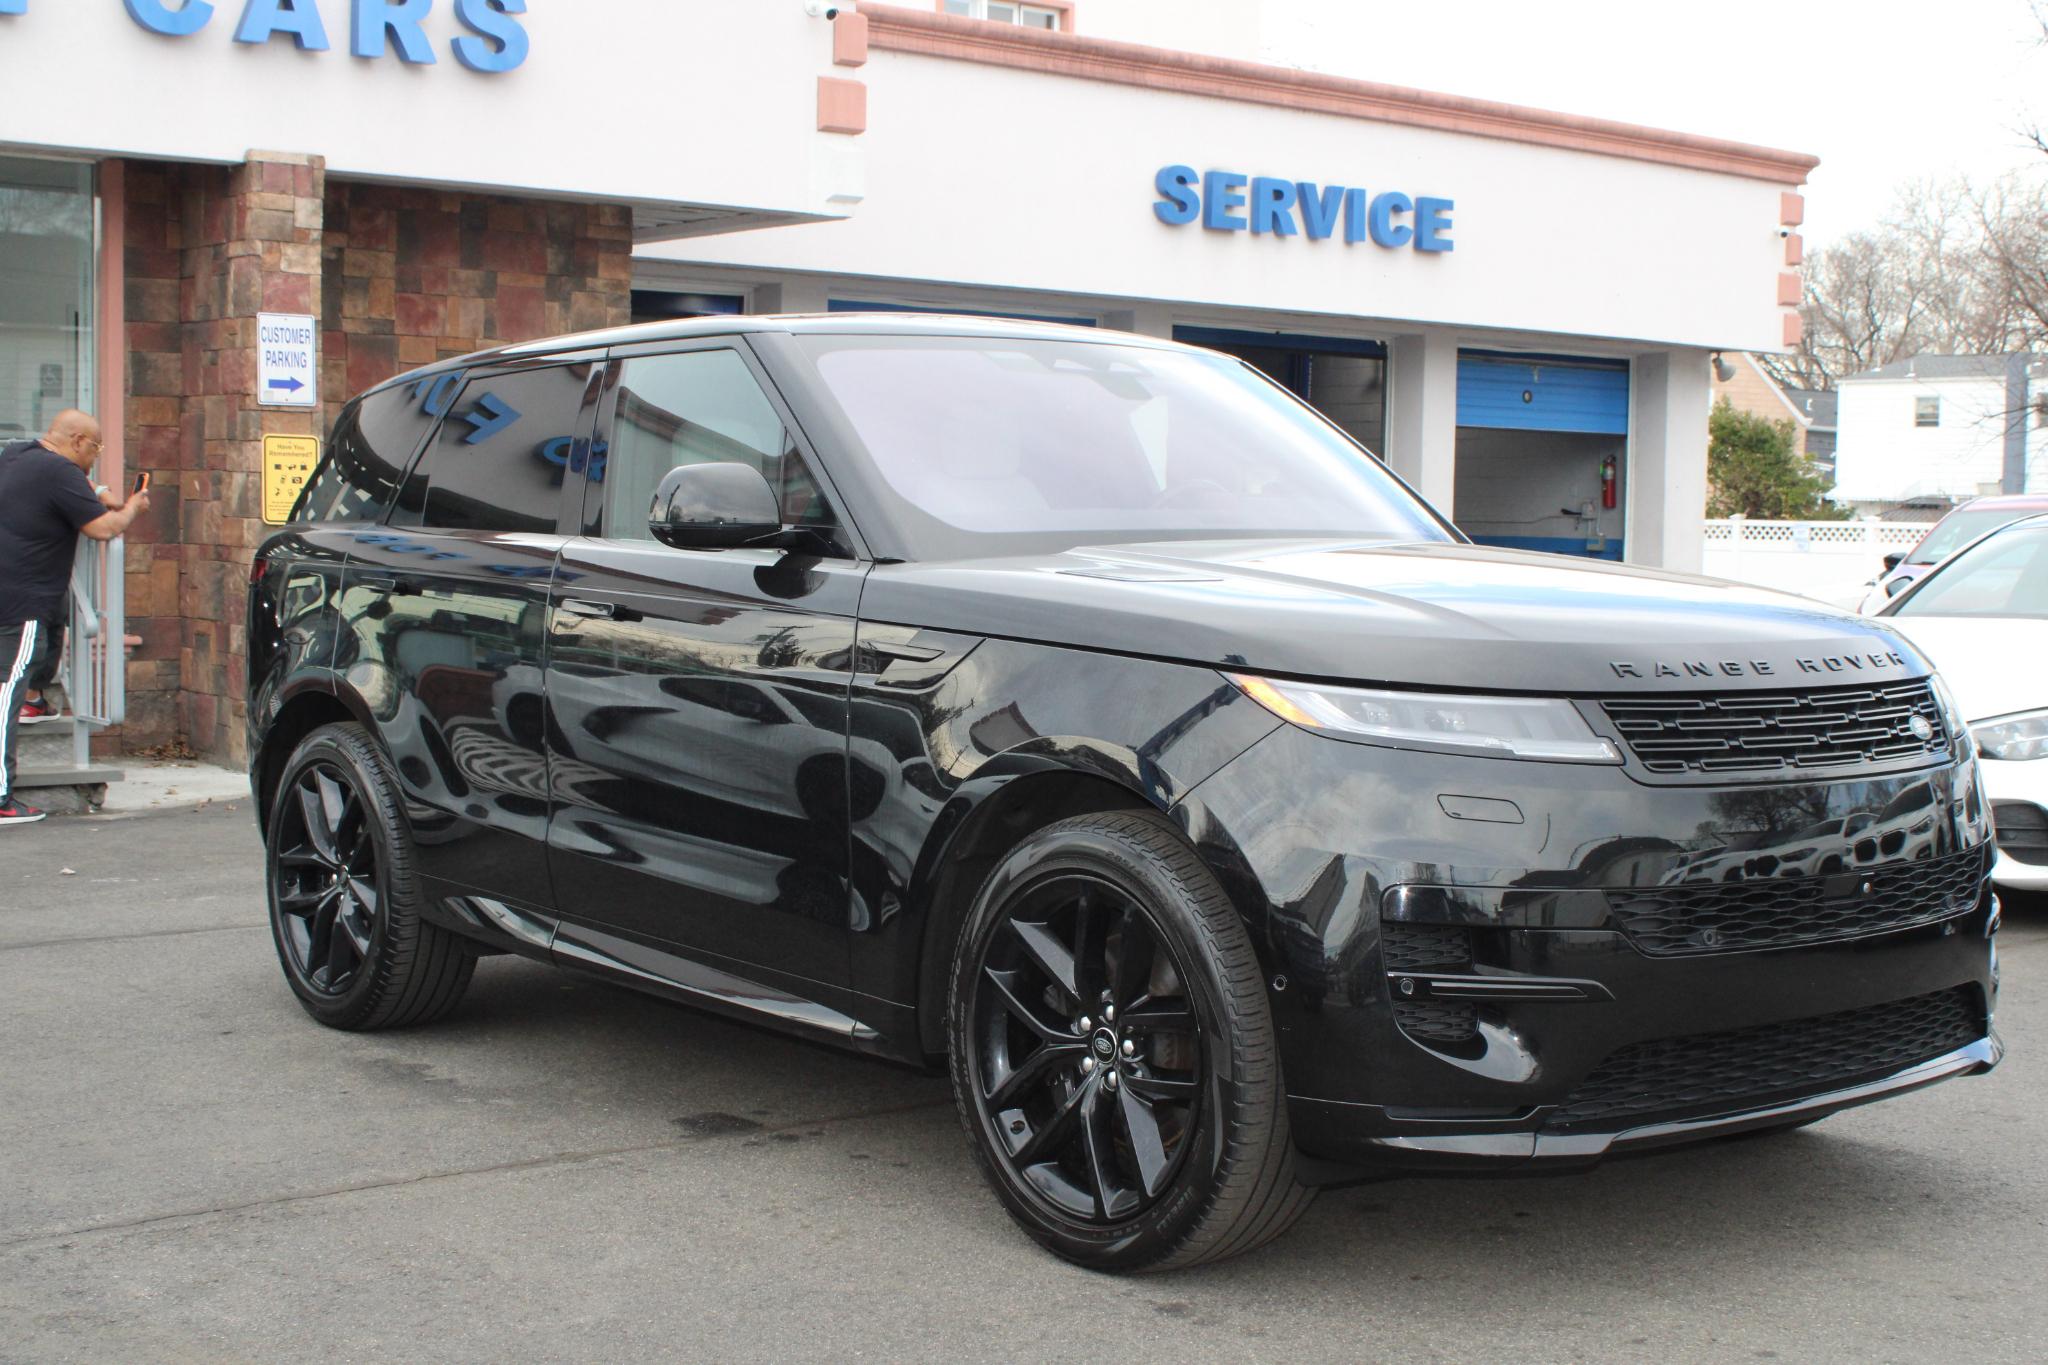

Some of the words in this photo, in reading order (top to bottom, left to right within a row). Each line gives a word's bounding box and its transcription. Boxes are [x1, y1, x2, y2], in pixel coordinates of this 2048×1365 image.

[1153, 165, 1454, 252] SERVICE
[261, 326, 311, 345] CUSTOMER
[265, 350, 307, 369] PARKING
[1609, 659, 1775, 679] RANGE
[1796, 651, 1905, 673] ROVER
